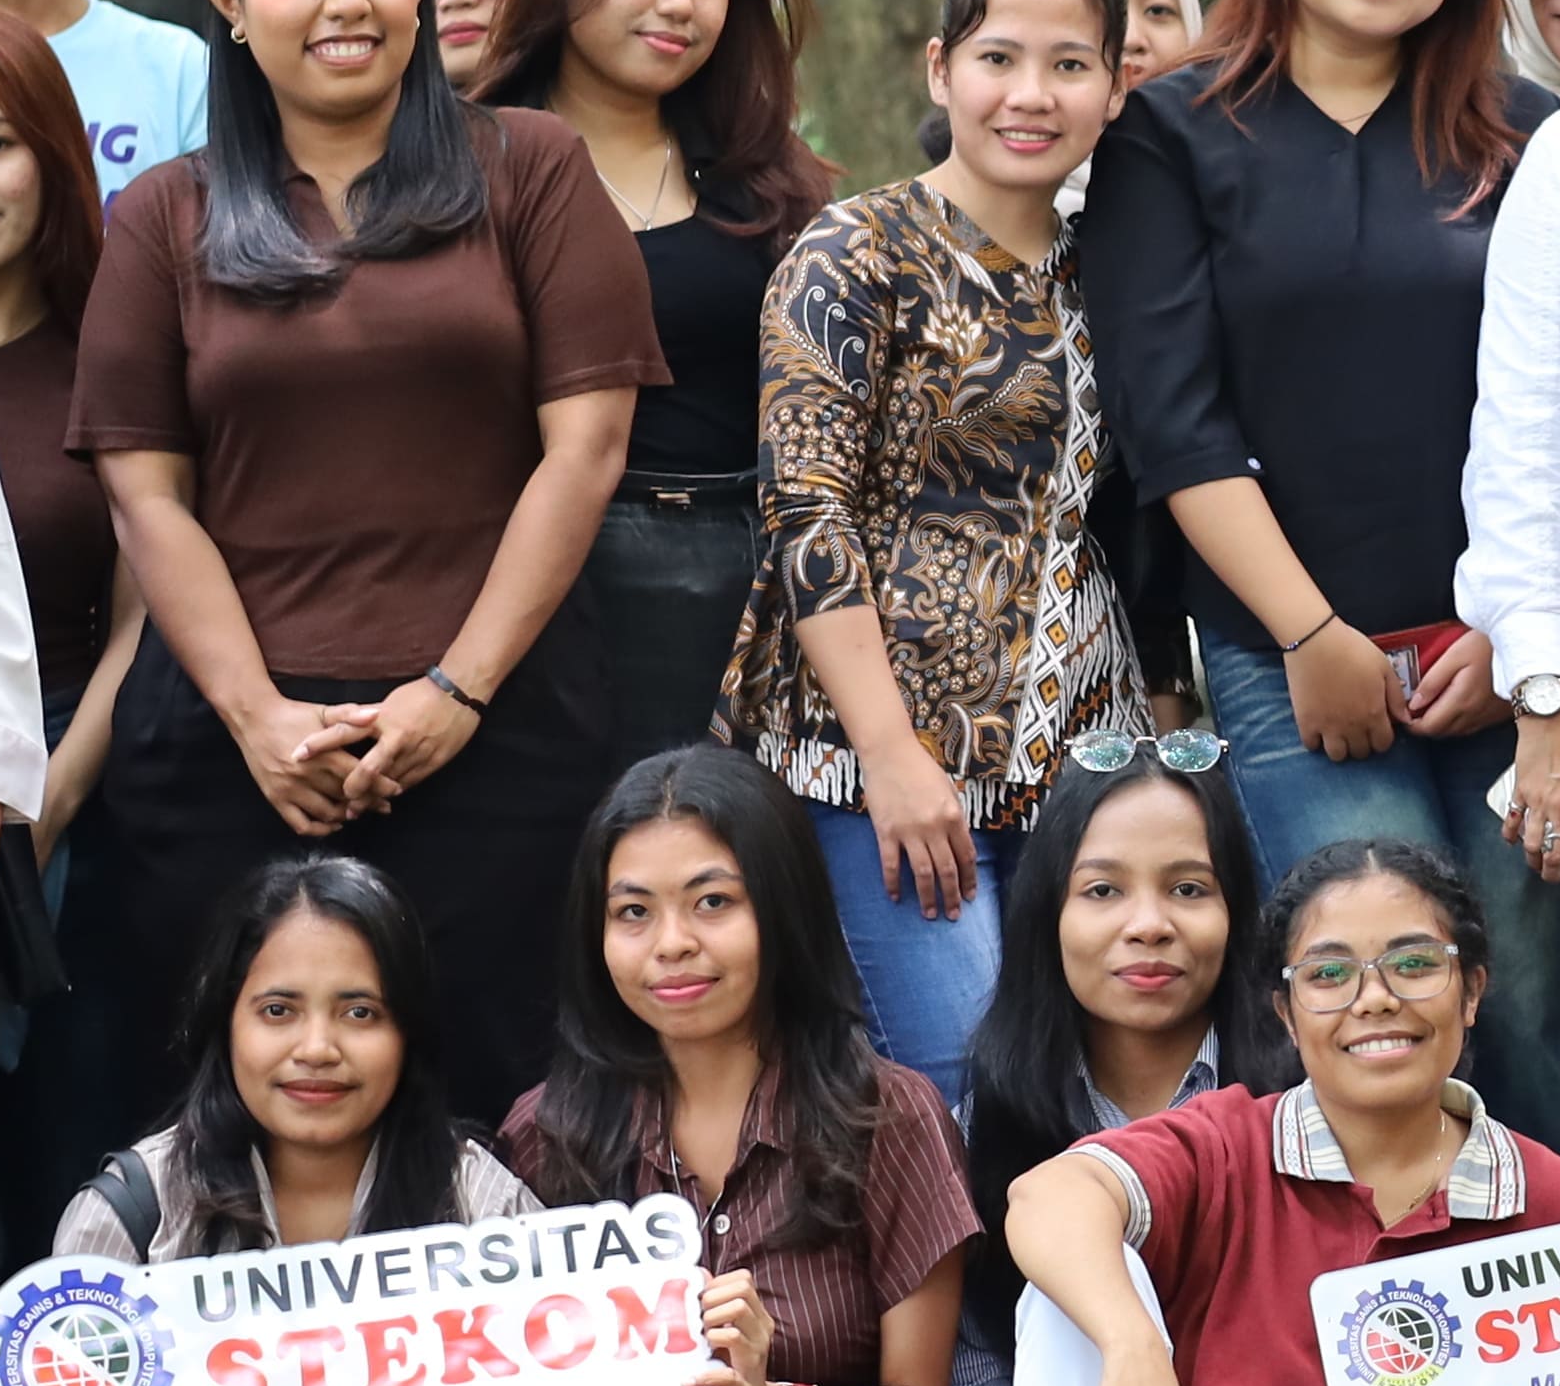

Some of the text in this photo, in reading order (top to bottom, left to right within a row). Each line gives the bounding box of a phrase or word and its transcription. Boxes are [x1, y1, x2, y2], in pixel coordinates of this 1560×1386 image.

[193, 1211, 686, 1323] UNIVERSITAS
[18, 1297, 54, 1331] SAINS
[54, 1292, 66, 1305] &
[67, 1288, 140, 1326] TEKNOLOGI
[1356, 1299, 1378, 1324] SAINS
[1387, 1290, 1439, 1316] TEKNOLOGI
[1435, 1312, 1450, 1367] KOMPUTER
